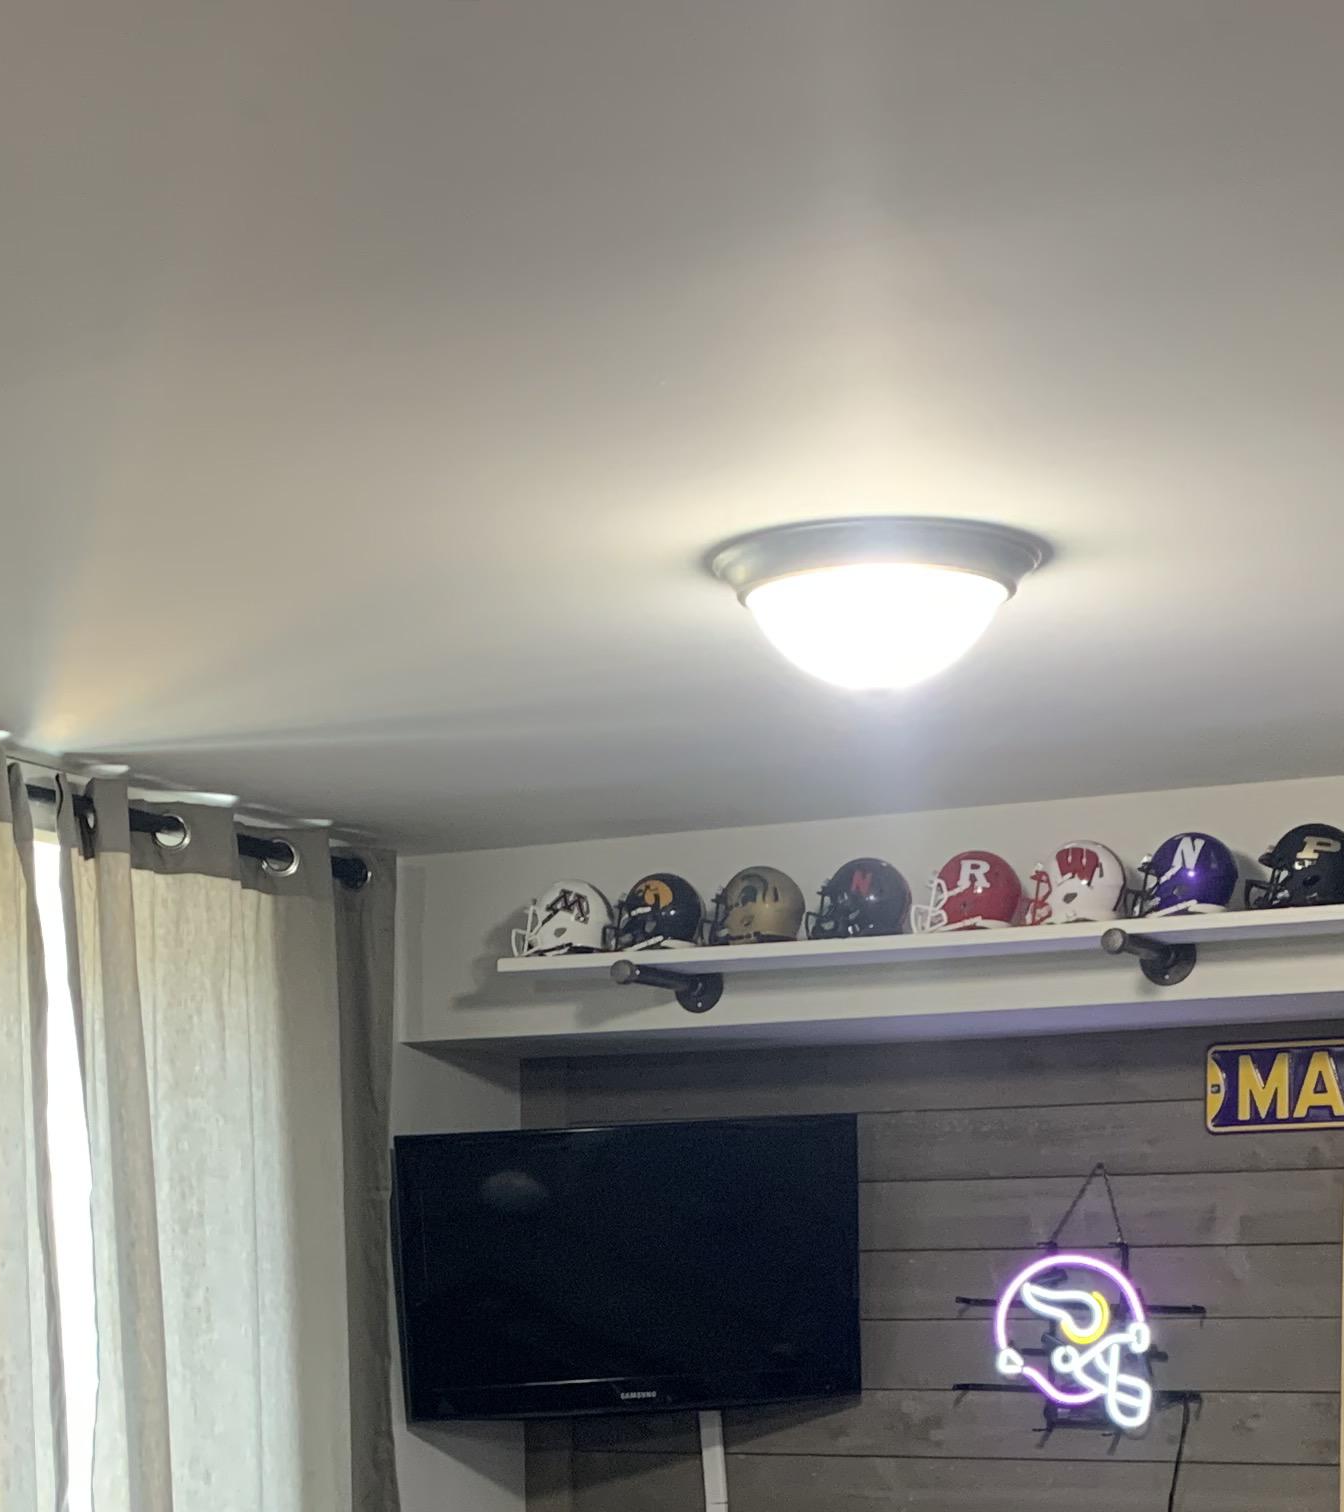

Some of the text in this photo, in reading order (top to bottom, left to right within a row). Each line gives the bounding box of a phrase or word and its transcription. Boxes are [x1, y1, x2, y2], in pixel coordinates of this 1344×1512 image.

[1171, 836, 1206, 870] N
[1296, 836, 1342, 859] P
[957, 859, 991, 889] R
